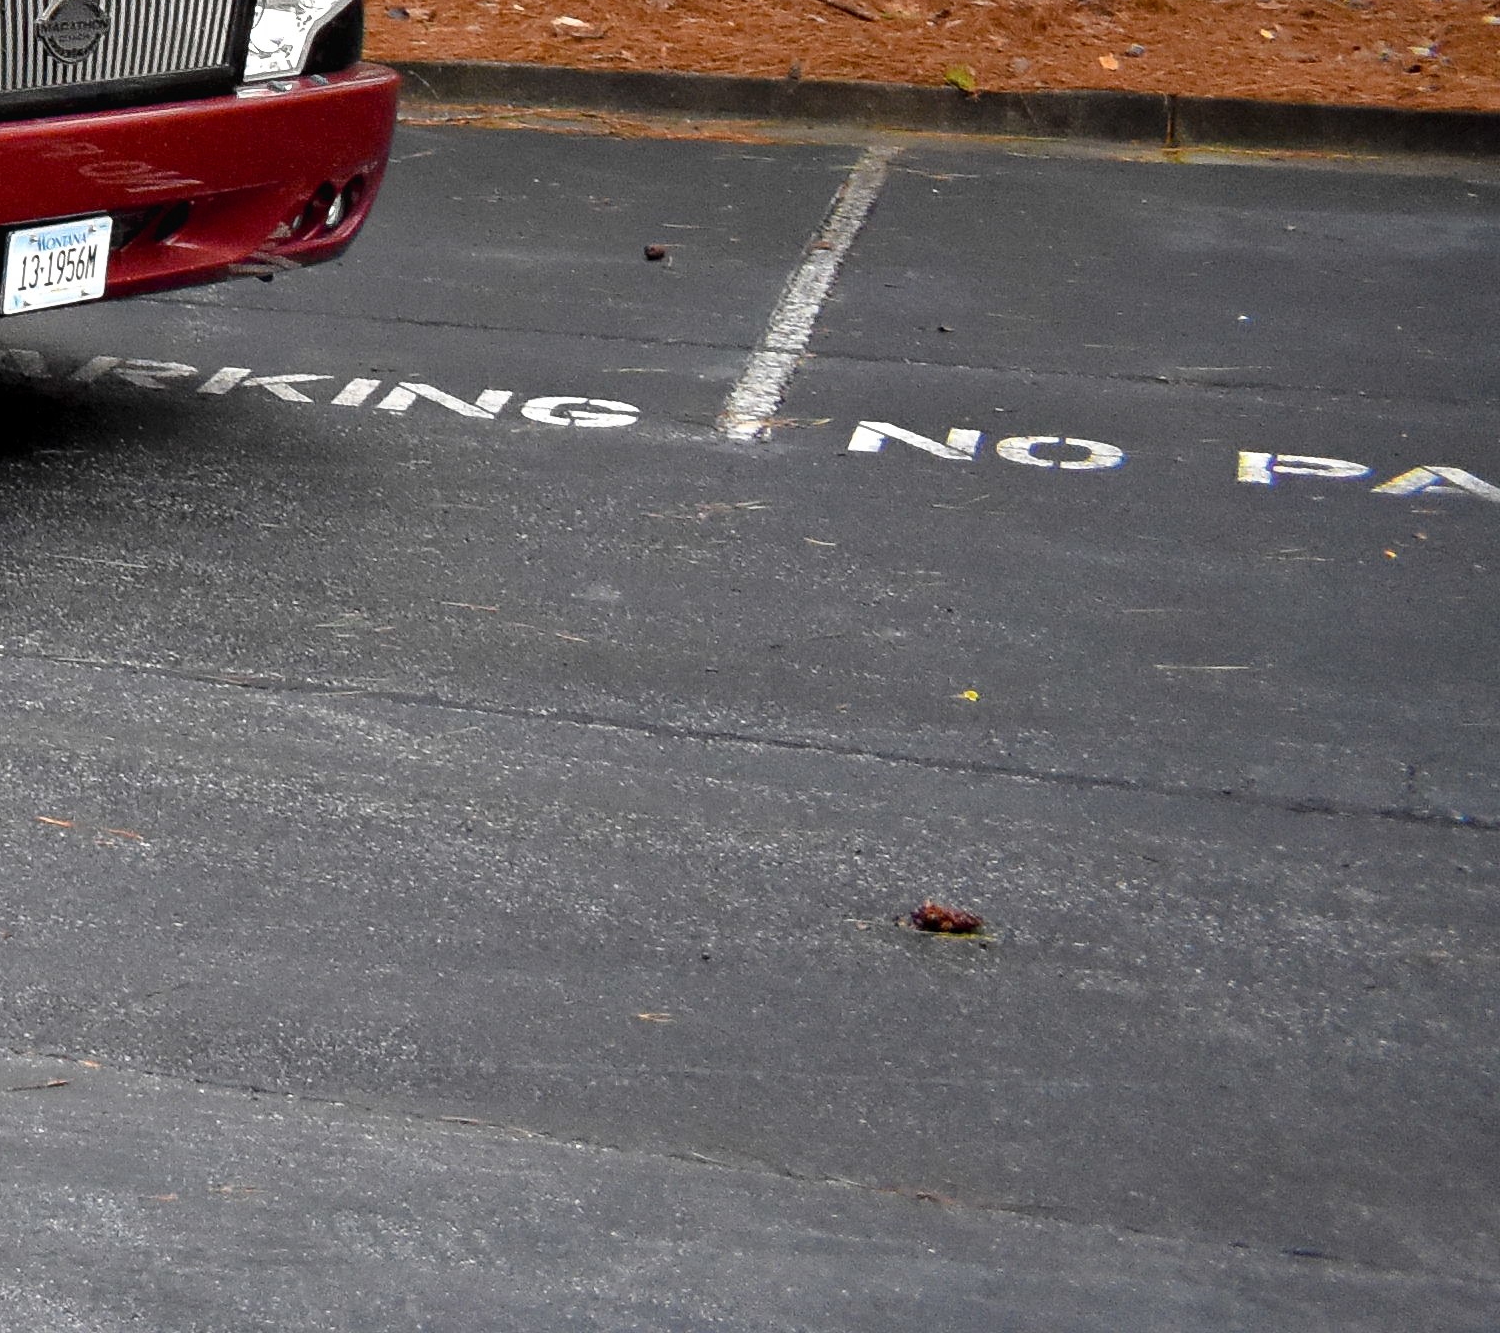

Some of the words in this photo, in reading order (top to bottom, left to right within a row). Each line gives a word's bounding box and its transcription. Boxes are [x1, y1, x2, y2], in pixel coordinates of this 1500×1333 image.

[37, 232, 88, 251] MONTANA
[847, 420, 1128, 470] NO
[1236, 450, 1500, 503] PA
